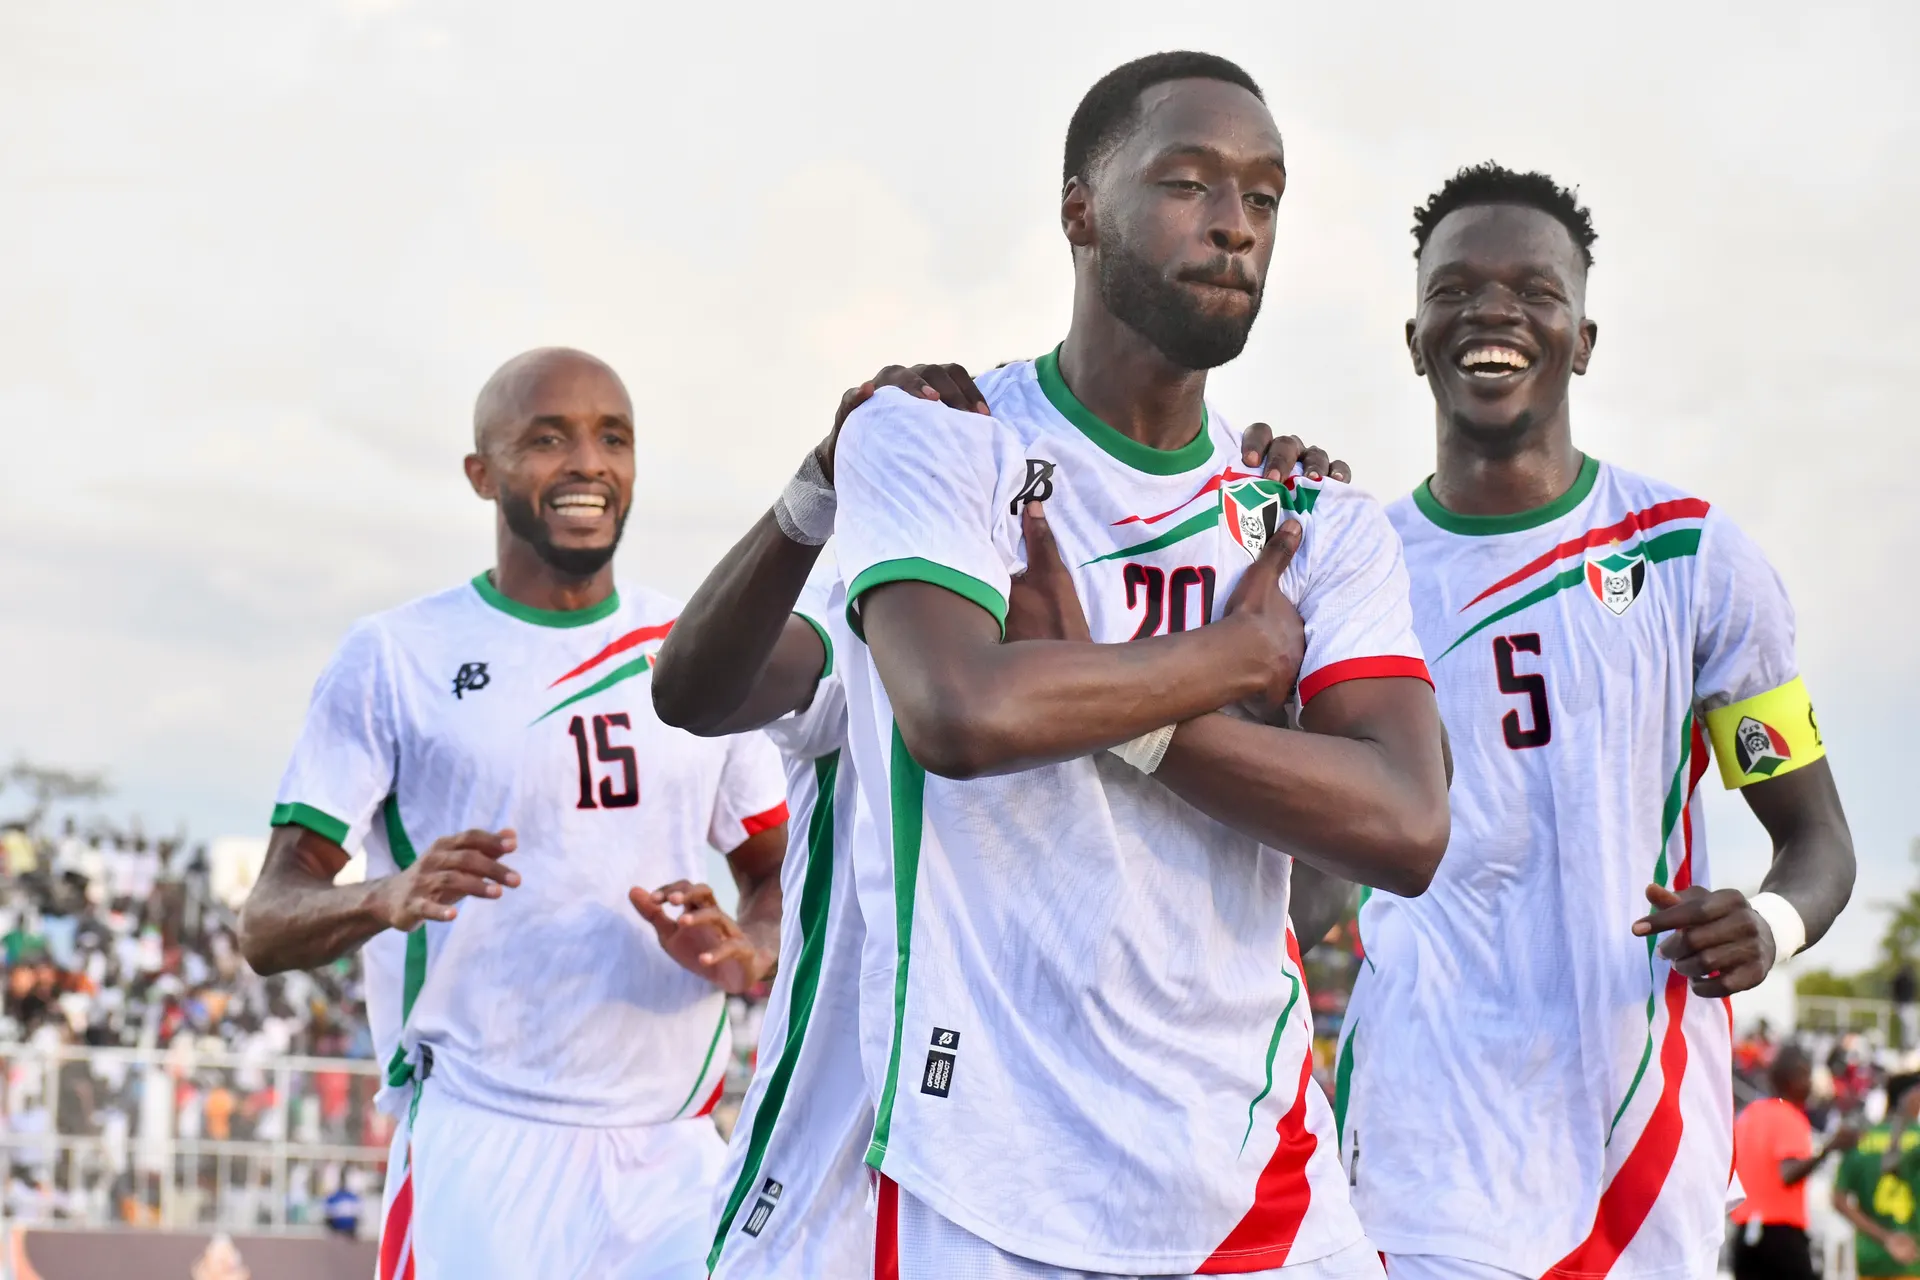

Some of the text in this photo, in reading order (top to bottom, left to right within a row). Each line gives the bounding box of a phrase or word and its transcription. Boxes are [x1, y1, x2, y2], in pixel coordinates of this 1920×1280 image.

[1123, 562, 1216, 640] 20
[1492, 632, 1551, 750] 5
[568, 712, 639, 810] 15
